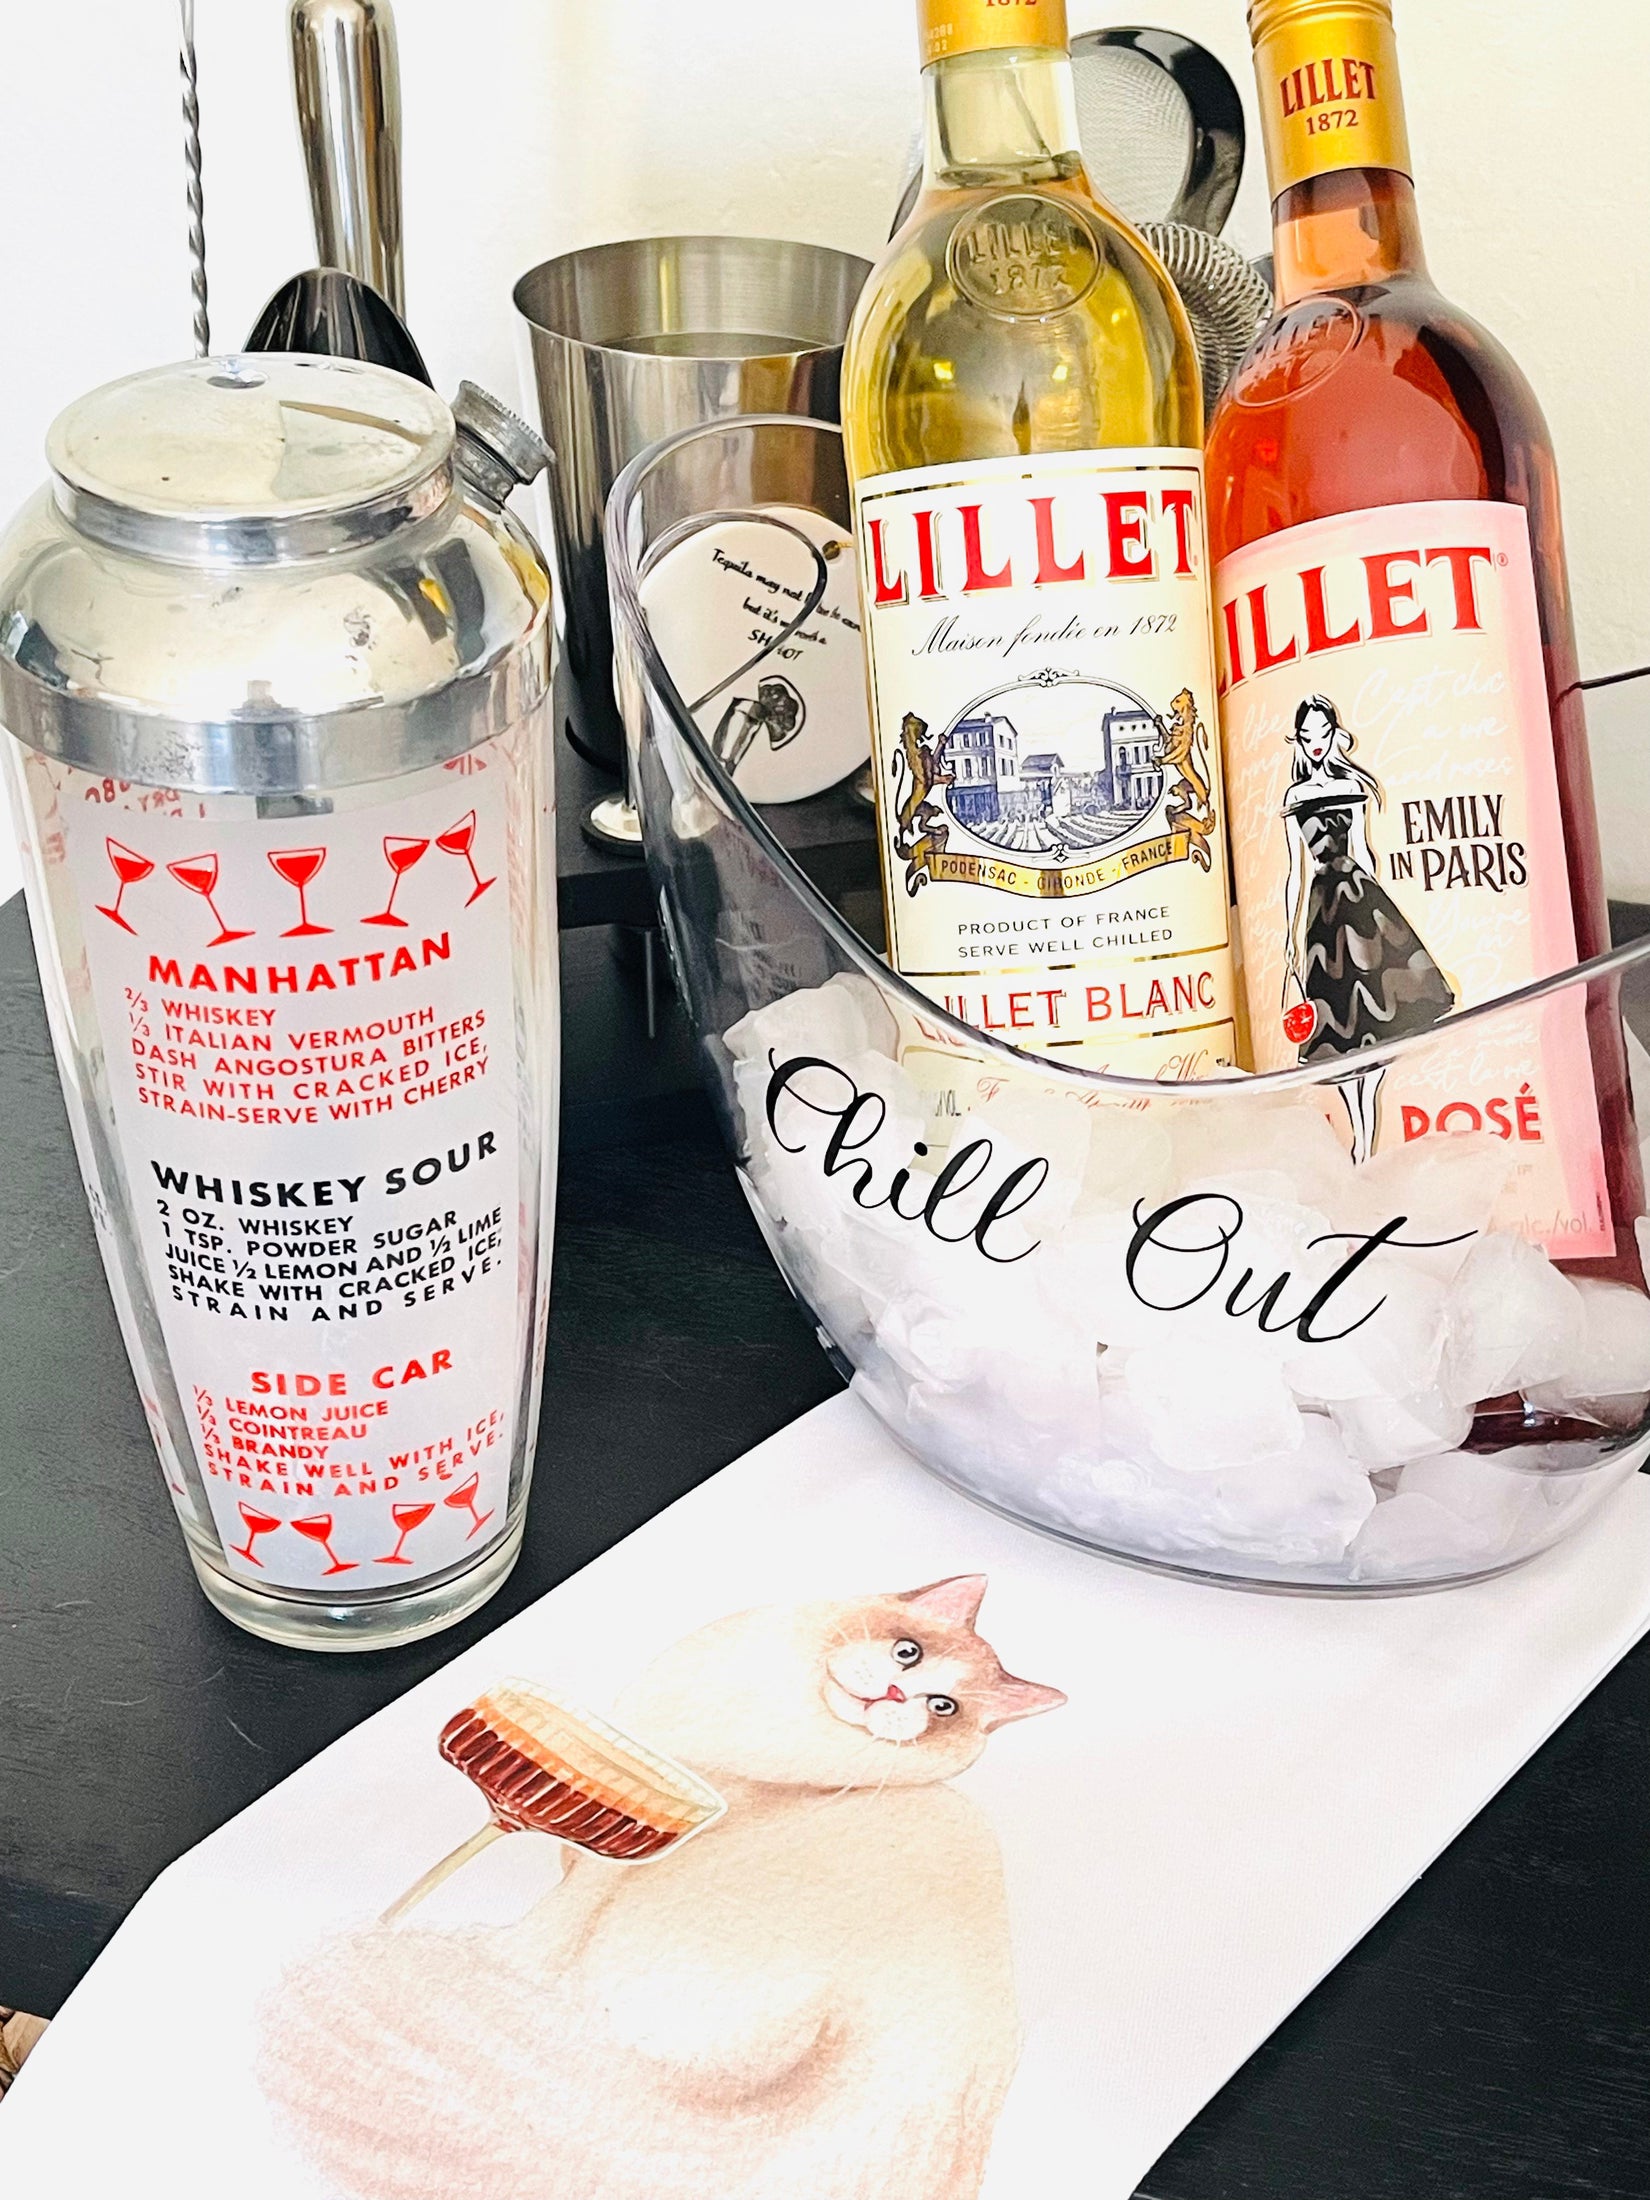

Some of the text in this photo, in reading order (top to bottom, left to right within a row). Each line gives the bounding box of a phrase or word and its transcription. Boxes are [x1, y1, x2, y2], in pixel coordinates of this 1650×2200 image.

[1279, 57, 1377, 118] LILLET
[1306, 109, 1359, 135] 1872
[868, 490, 1193, 608] LILLET
[712, 548, 753, 578] Tequila
[756, 575, 780, 594] may
[782, 588, 803, 602] not
[743, 597, 762, 615] but
[763, 608, 778, 623] it's
[912, 615, 1004, 656] Maison
[1094, 625, 1119, 641] en
[1130, 614, 1177, 636] 1872
[1218, 547, 1493, 697] ILLET
[1402, 794, 1505, 845] EMILY
[941, 840, 1173, 892] PODENSAC GIRONDE FRANCE
[1389, 842, 1528, 893] IN PARIS
[958, 906, 1170, 935] PRODUCT OF FRANCE
[958, 929, 1173, 958] SERVE WELL CHILLED
[149, 931, 451, 994] MANHATTAN
[161, 999, 276, 1028] WHISKEY
[1085, 971, 1216, 1022] BLANC
[131, 1009, 486, 1077] DASH ANGOSTURA BITTERS
[165, 1025, 272, 1052] ITALIAN
[287, 1005, 434, 1050] VERMOUTH
[135, 1037, 488, 1100] STIR WITH CRACKED ICE,
[138, 1055, 489, 1124] STRAIN-SERVE WITH CHERRY
[150, 1130, 498, 1208] WHISKEY SOUR
[156, 1199, 354, 1235] 2 OZ. WHISKEY
[764, 1047, 1478, 1343] Chill Out
[161, 1209, 457, 1258] 1 TSP. POWDER SUGAR
[165, 1242, 226, 1274] JUICE
[265, 1261, 358, 1280] LEMON
[365, 1246, 422, 1274] AND
[457, 1206, 503, 1245] LIME
[168, 1230, 503, 1301] SHAKE WITH CRACKED ICE,
[172, 1257, 503, 1321] STRAIN AND SERVE.
[250, 1348, 453, 1396] SIDE CAR
[225, 1397, 307, 1421] LEMON
[321, 1400, 390, 1422] JUICE
[228, 1417, 368, 1441] COINTREAU
[204, 1443, 289, 1476] SHAKE
[306, 1462, 374, 1478] WELL
[388, 1437, 454, 1471] WITH
[208, 1432, 505, 1497] STRAIN AND SERVE.
[231, 1435, 330, 1459] BRANDY
